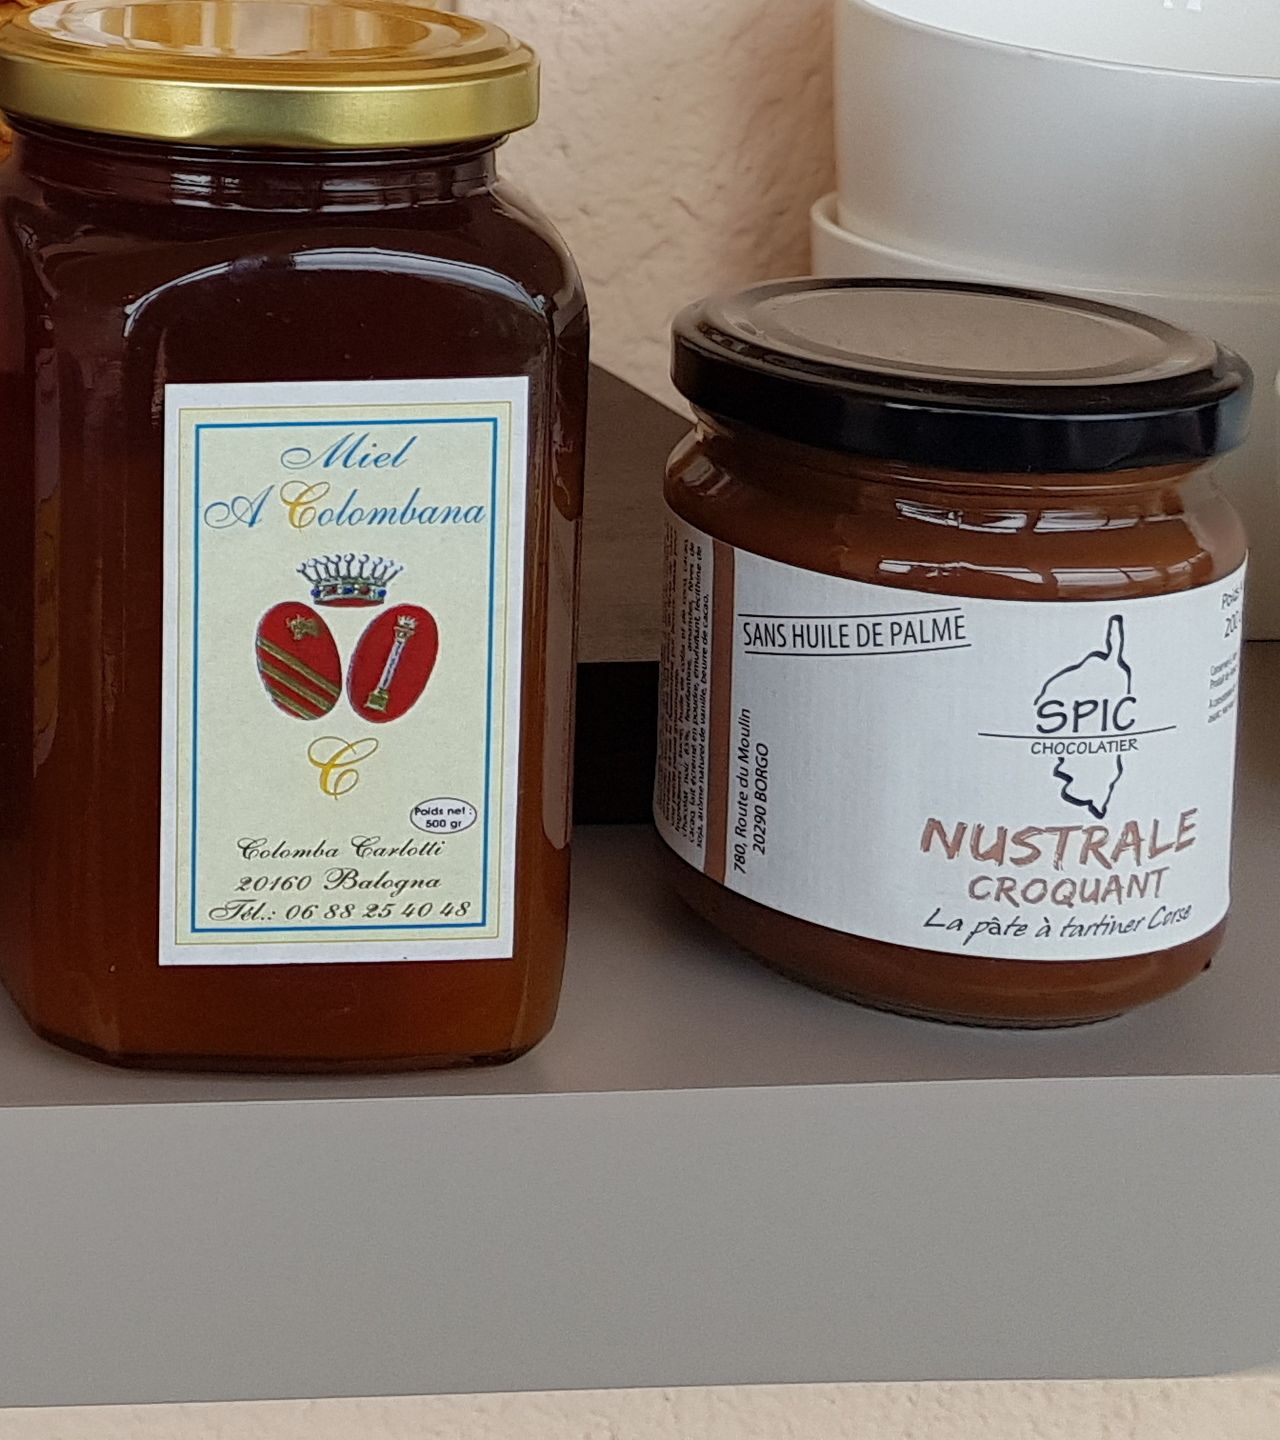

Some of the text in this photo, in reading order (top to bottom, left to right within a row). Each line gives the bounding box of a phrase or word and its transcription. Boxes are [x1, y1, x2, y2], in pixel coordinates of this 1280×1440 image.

[279, 431, 418, 471] Miel
[203, 479, 487, 534] A Colombana
[743, 614, 967, 650] SANS HUILE DE PALME
[700, 646, 708, 685] beurre
[1035, 695, 1138, 735] SPIC
[697, 742, 705, 784] naturel
[1030, 736, 1140, 756] CHOCOLATIER
[307, 735, 380, 801] C
[414, 806, 443, 817] Poids
[446, 805, 467, 817] net
[733, 708, 751, 875] 780, Route du Moulin
[752, 742, 769, 856] 20290 BORGO
[425, 818, 463, 833] 500 gr
[919, 807, 1199, 871] NUSTRALE
[236, 834, 447, 862] Colomba Carlotti
[234, 866, 443, 899] 20160 Balogna
[967, 866, 1170, 909] CROQUANT
[285, 903, 319, 922] 06
[323, 903, 357, 921] 88
[361, 902, 394, 920] 25
[400, 901, 434, 920] 40
[438, 900, 473, 919] 48
[922, 904, 1193, 946] La pâte à tartiner Corse
